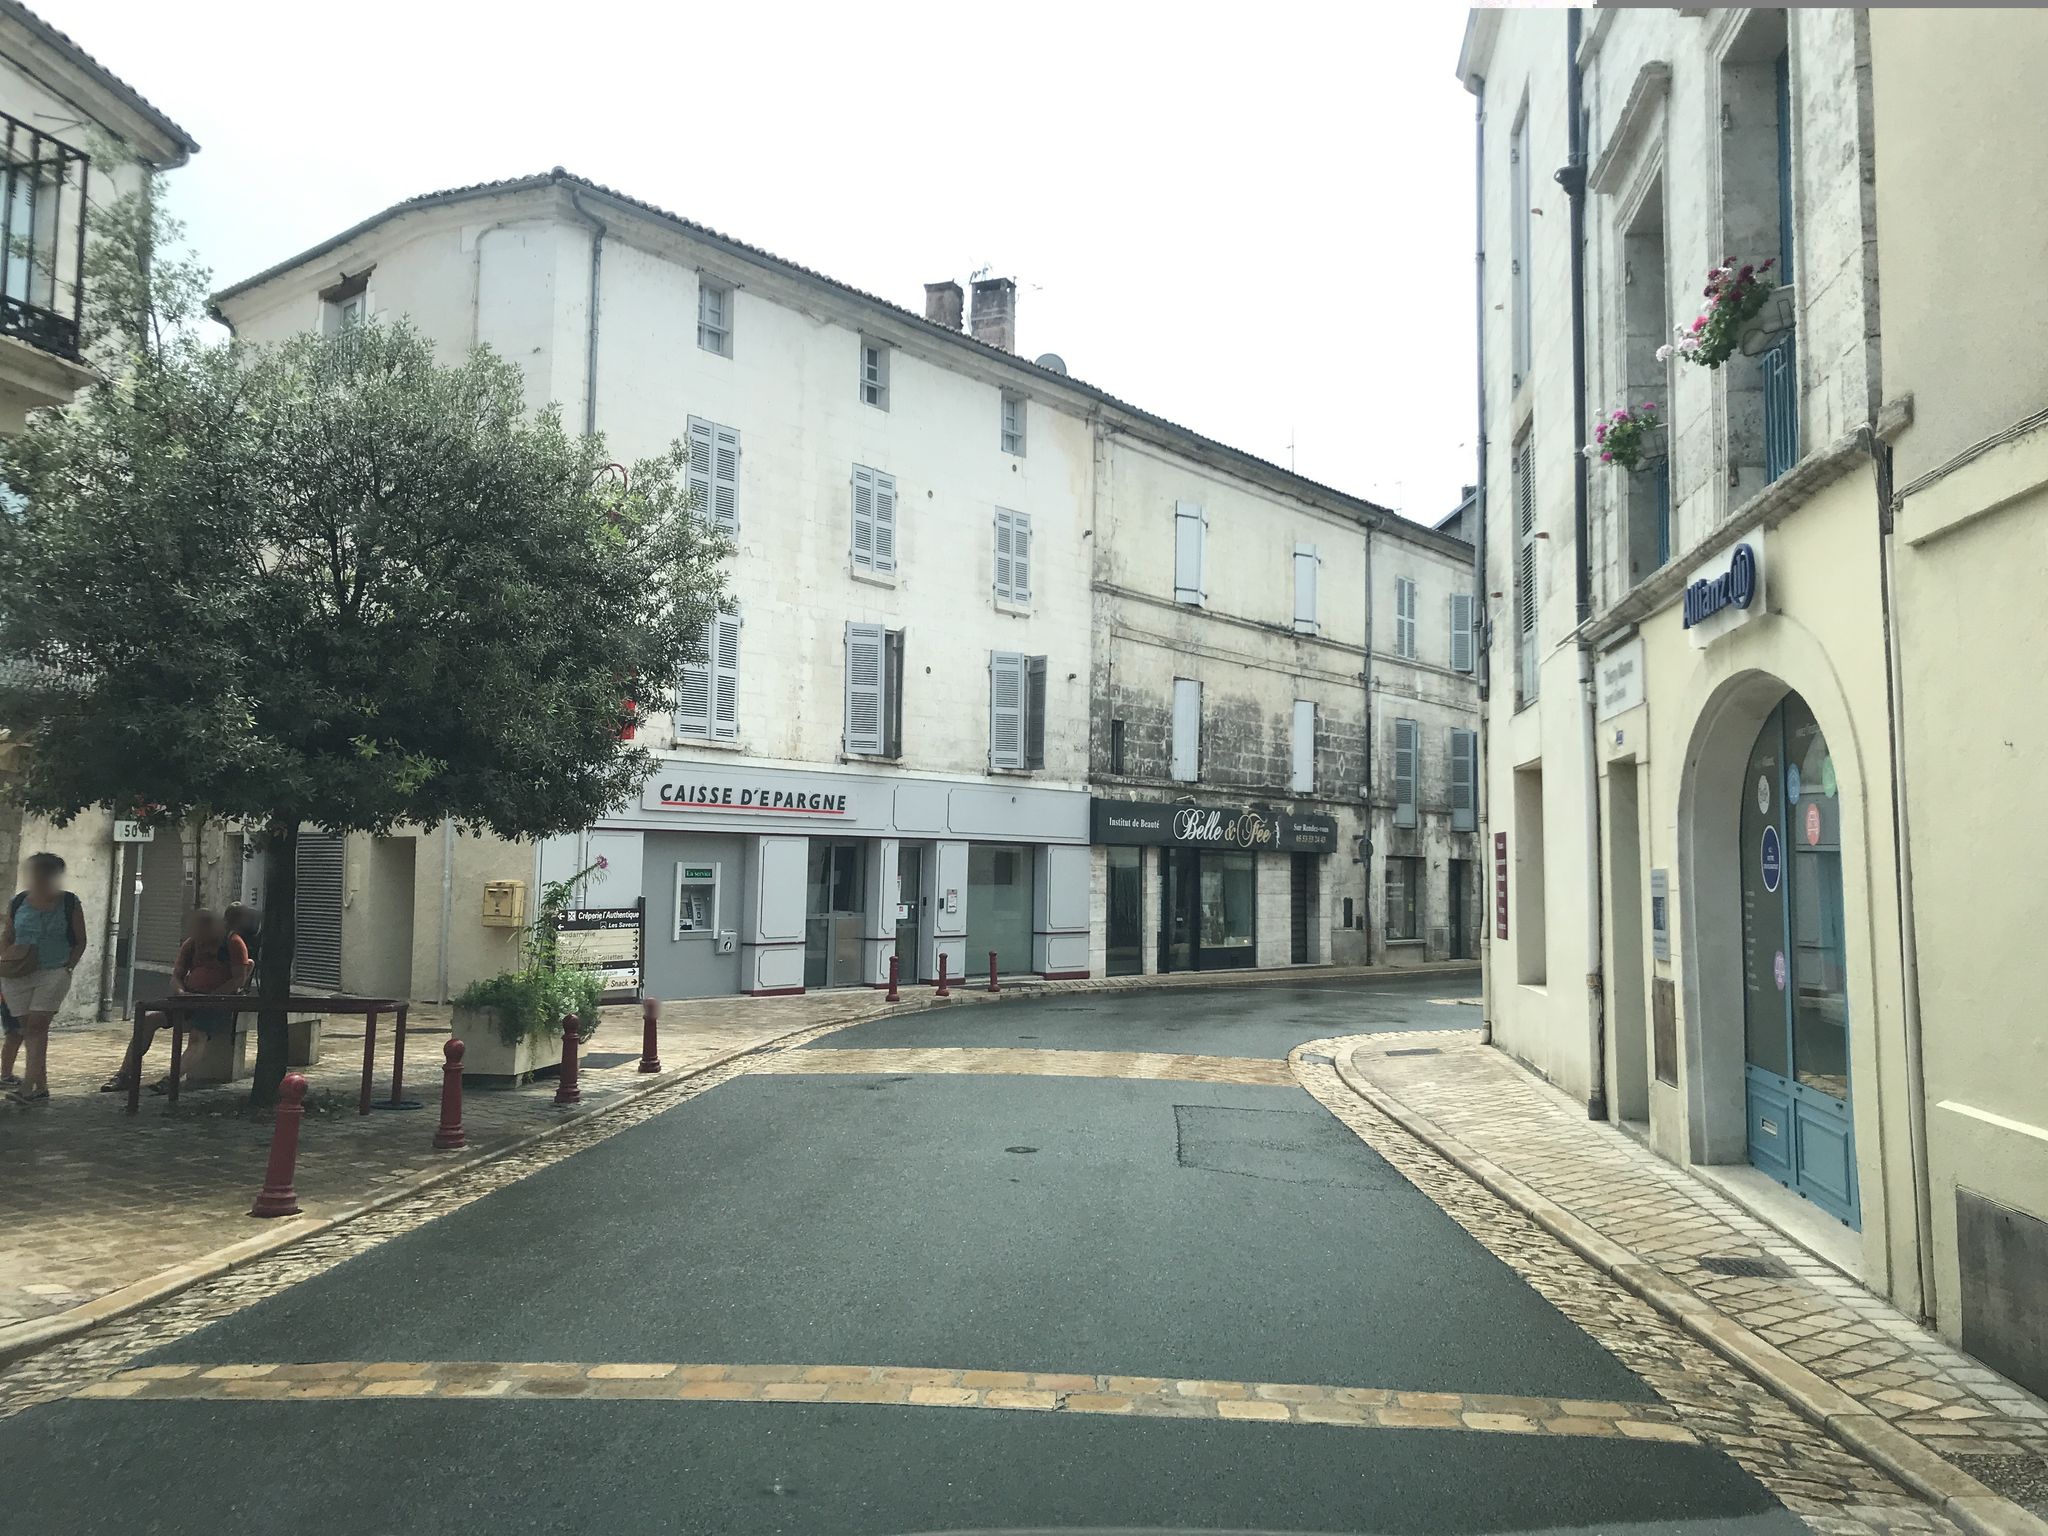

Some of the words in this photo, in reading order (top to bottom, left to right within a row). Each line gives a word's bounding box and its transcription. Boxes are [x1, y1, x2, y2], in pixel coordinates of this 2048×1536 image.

[1683, 572, 1731, 629] Allianz
[660, 784, 733, 804] CAISSE
[740, 789, 847, 811] D'EPARGNE
[1109, 816, 1131, 827] Institut
[1132, 818, 1139, 828] de
[1140, 819, 1160, 829] Beauté
[1173, 808, 1223, 840] Belle
[1224, 819, 1236, 841] &
[1237, 813, 1271, 848] Fée
[124, 824, 138, 838] 50
[578, 911, 602, 922] Crêperie
[610, 979, 629, 988] Snack
